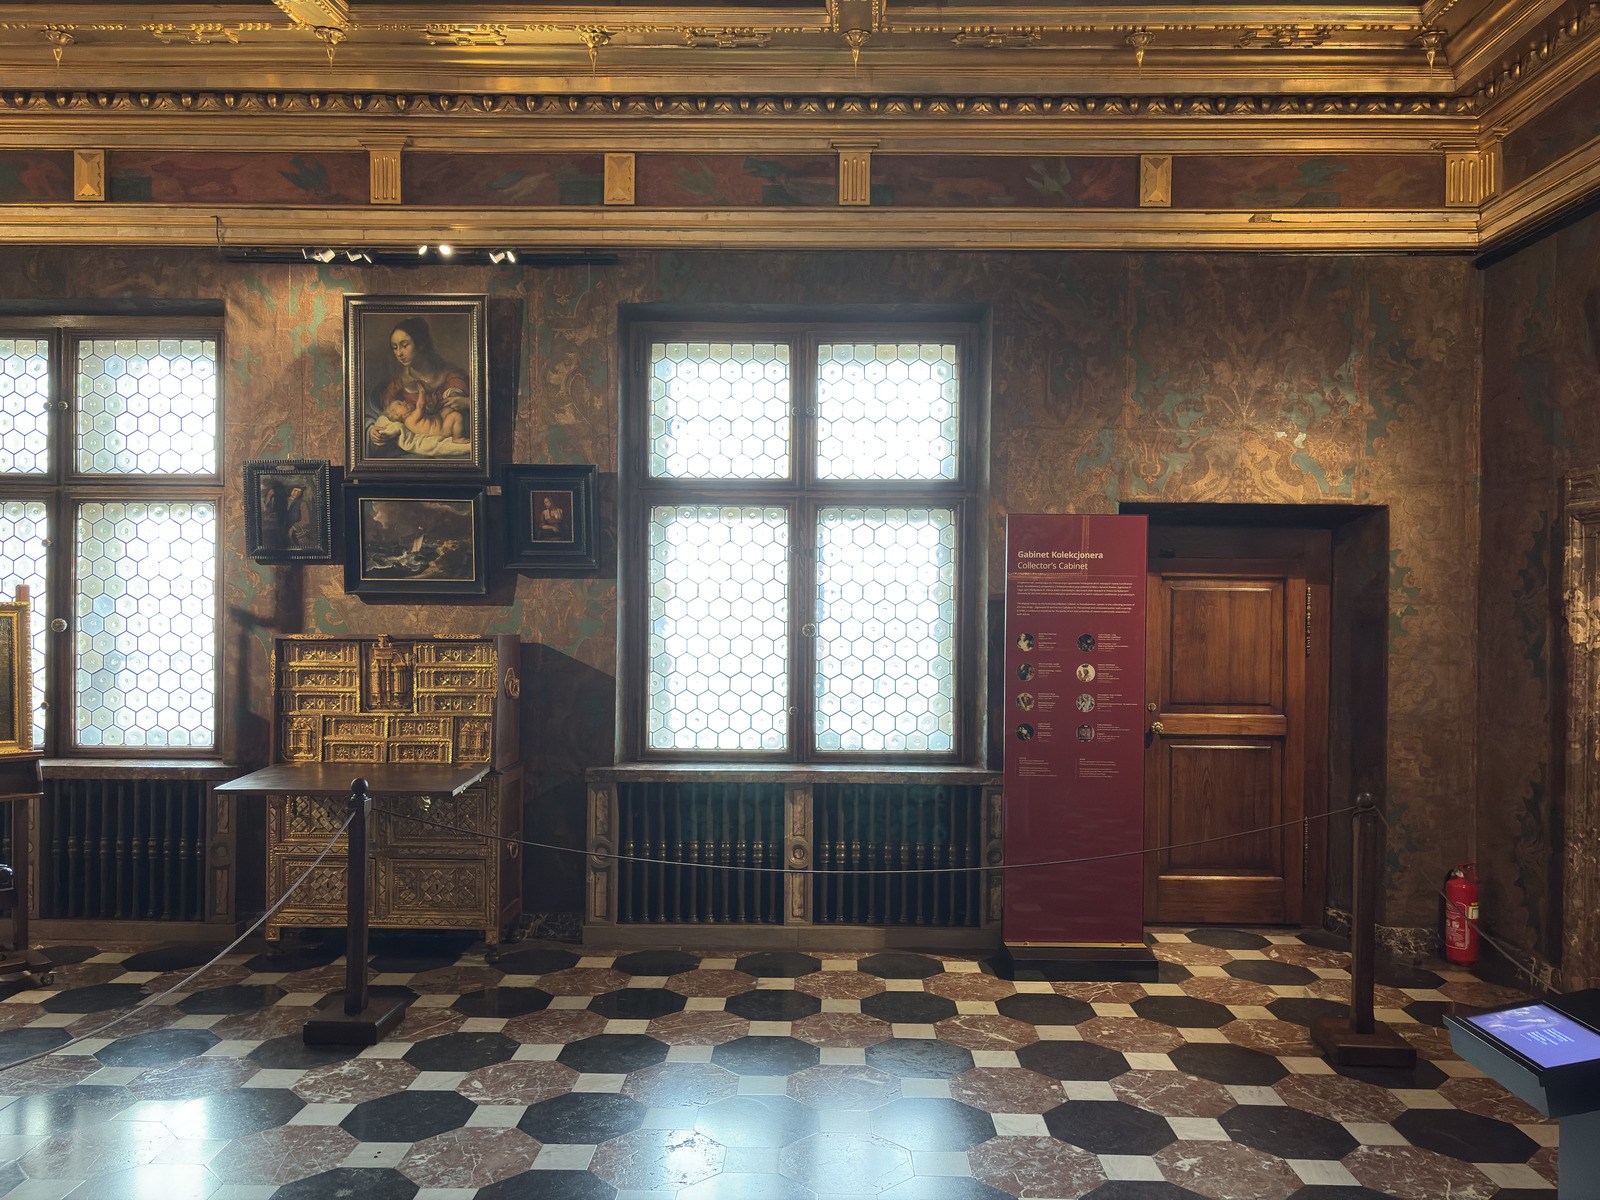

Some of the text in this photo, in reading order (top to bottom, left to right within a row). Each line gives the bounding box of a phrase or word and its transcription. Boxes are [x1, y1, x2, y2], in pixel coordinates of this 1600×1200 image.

[1017, 550, 1104, 561] Gabinet Kolekcjonera
[1017, 561, 1089, 571] Collector’s Cabinet
